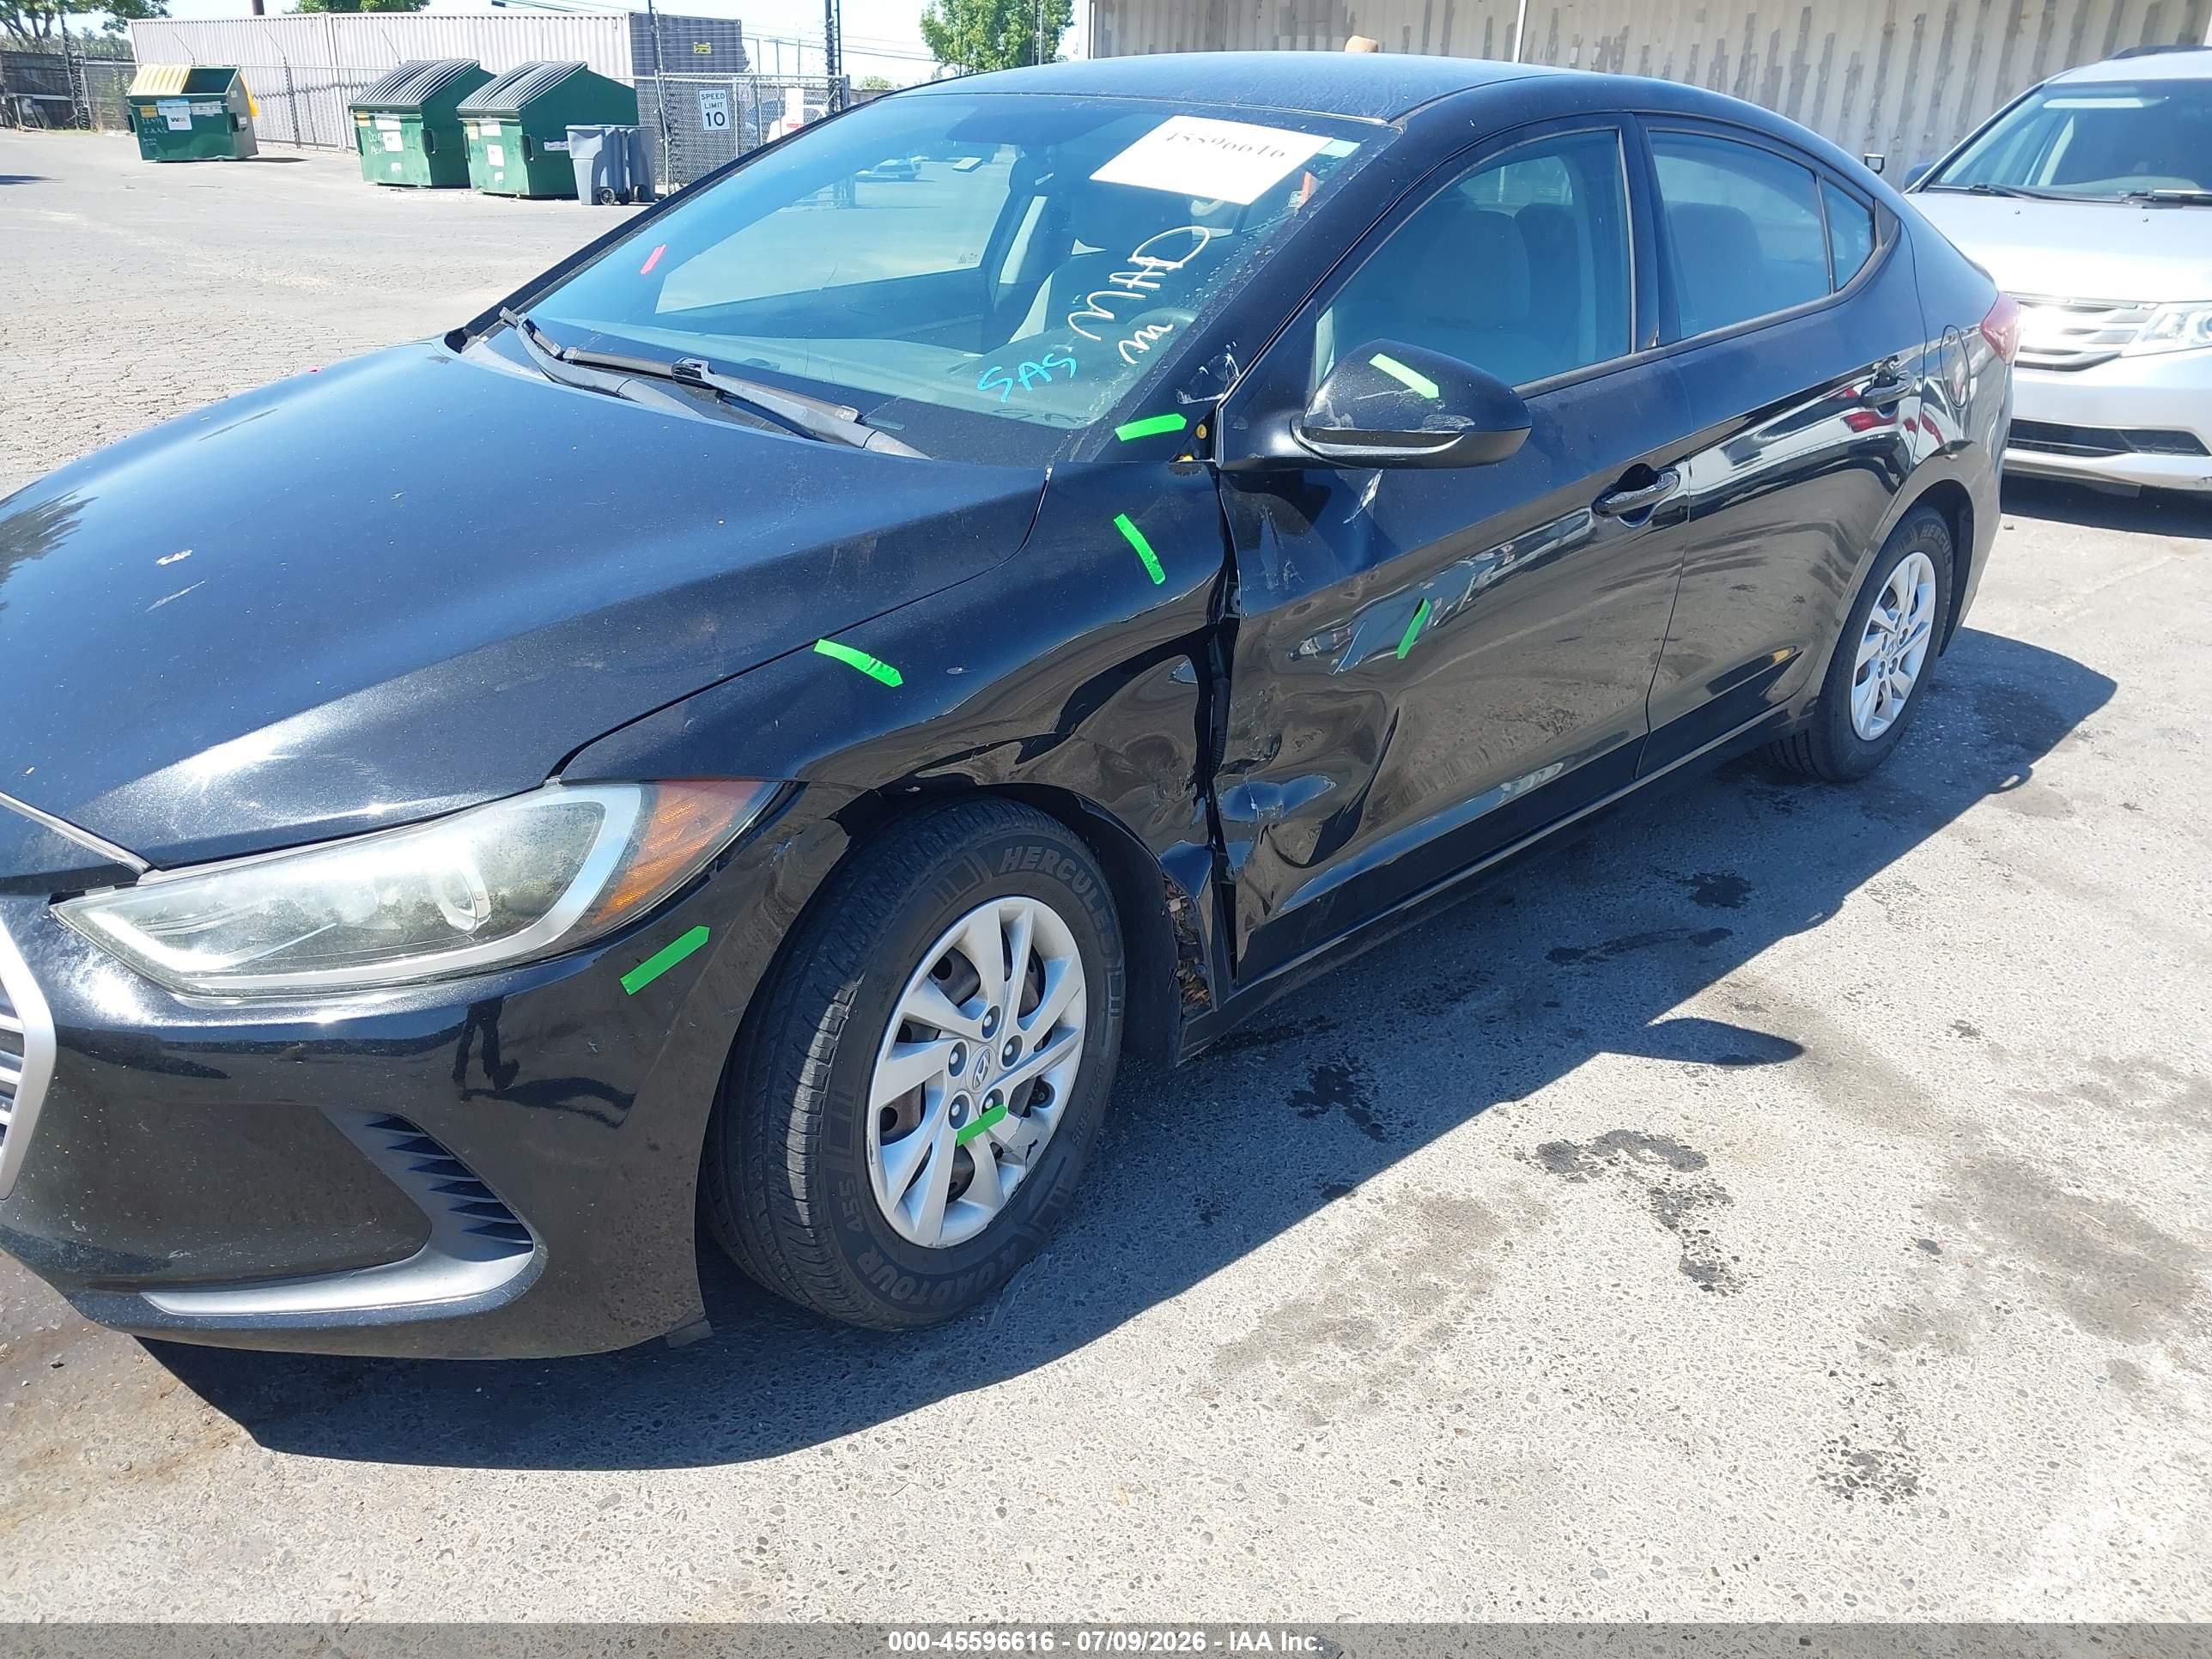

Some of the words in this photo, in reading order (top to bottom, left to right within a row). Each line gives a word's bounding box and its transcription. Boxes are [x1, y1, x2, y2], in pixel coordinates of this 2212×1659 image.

[701, 92, 726, 100] SPEED
[705, 112, 726, 127] 10
[977, 353, 1078, 404] SAS
[838, 1178, 866, 1232] 455
